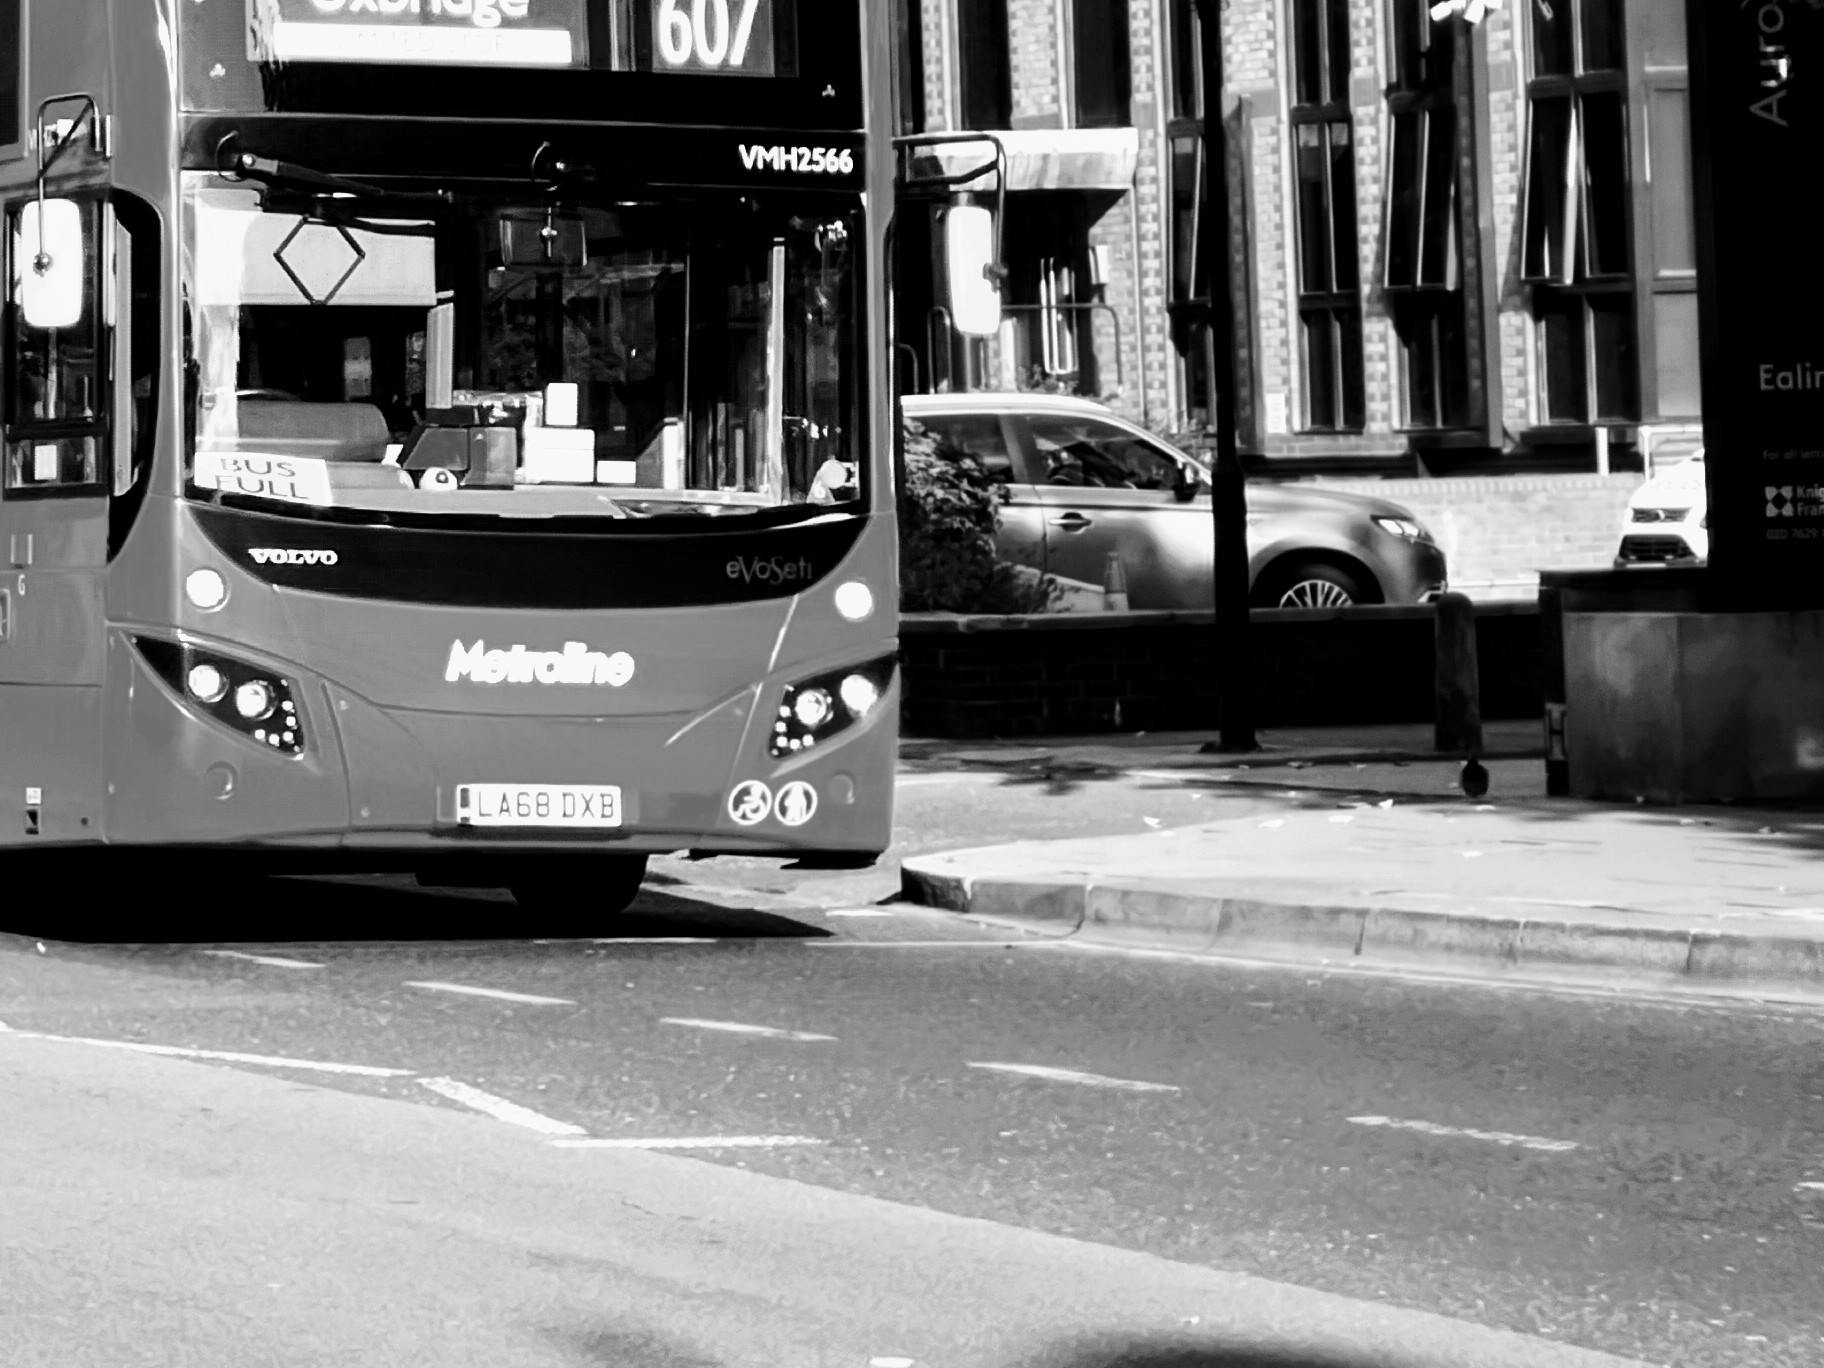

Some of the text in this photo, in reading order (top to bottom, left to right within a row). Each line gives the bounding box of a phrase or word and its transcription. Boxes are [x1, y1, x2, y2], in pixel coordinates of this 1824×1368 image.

[738, 144, 855, 175] VMH2566
[219, 457, 298, 479] BUS
[214, 474, 310, 500] FULL
[248, 546, 338, 566] VOLVO
[444, 638, 636, 687] Metroline
[477, 789, 616, 820] LA68 DXB
